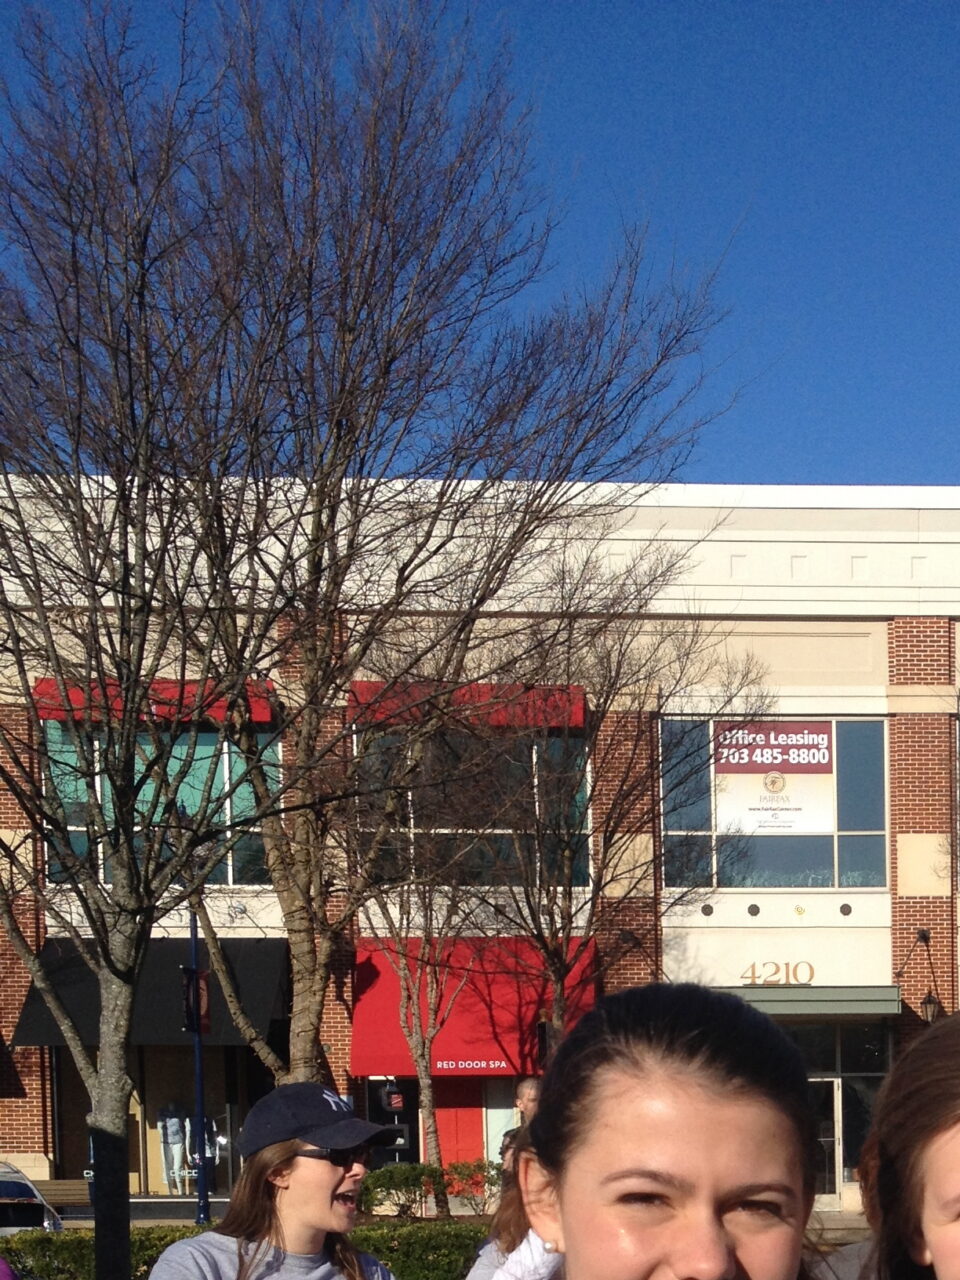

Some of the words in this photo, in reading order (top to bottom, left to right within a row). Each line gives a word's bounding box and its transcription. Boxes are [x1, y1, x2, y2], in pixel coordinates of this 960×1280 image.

[719, 729, 765, 745] Office
[769, 729, 828, 749] Leasing
[719, 748, 749, 764] 703
[751, 748, 830, 764] 485-8800
[739, 960, 815, 985] 4210
[436, 1060, 456, 1069] RED
[458, 1060, 487, 1069] DOOR
[489, 1060, 507, 1069] SPA
